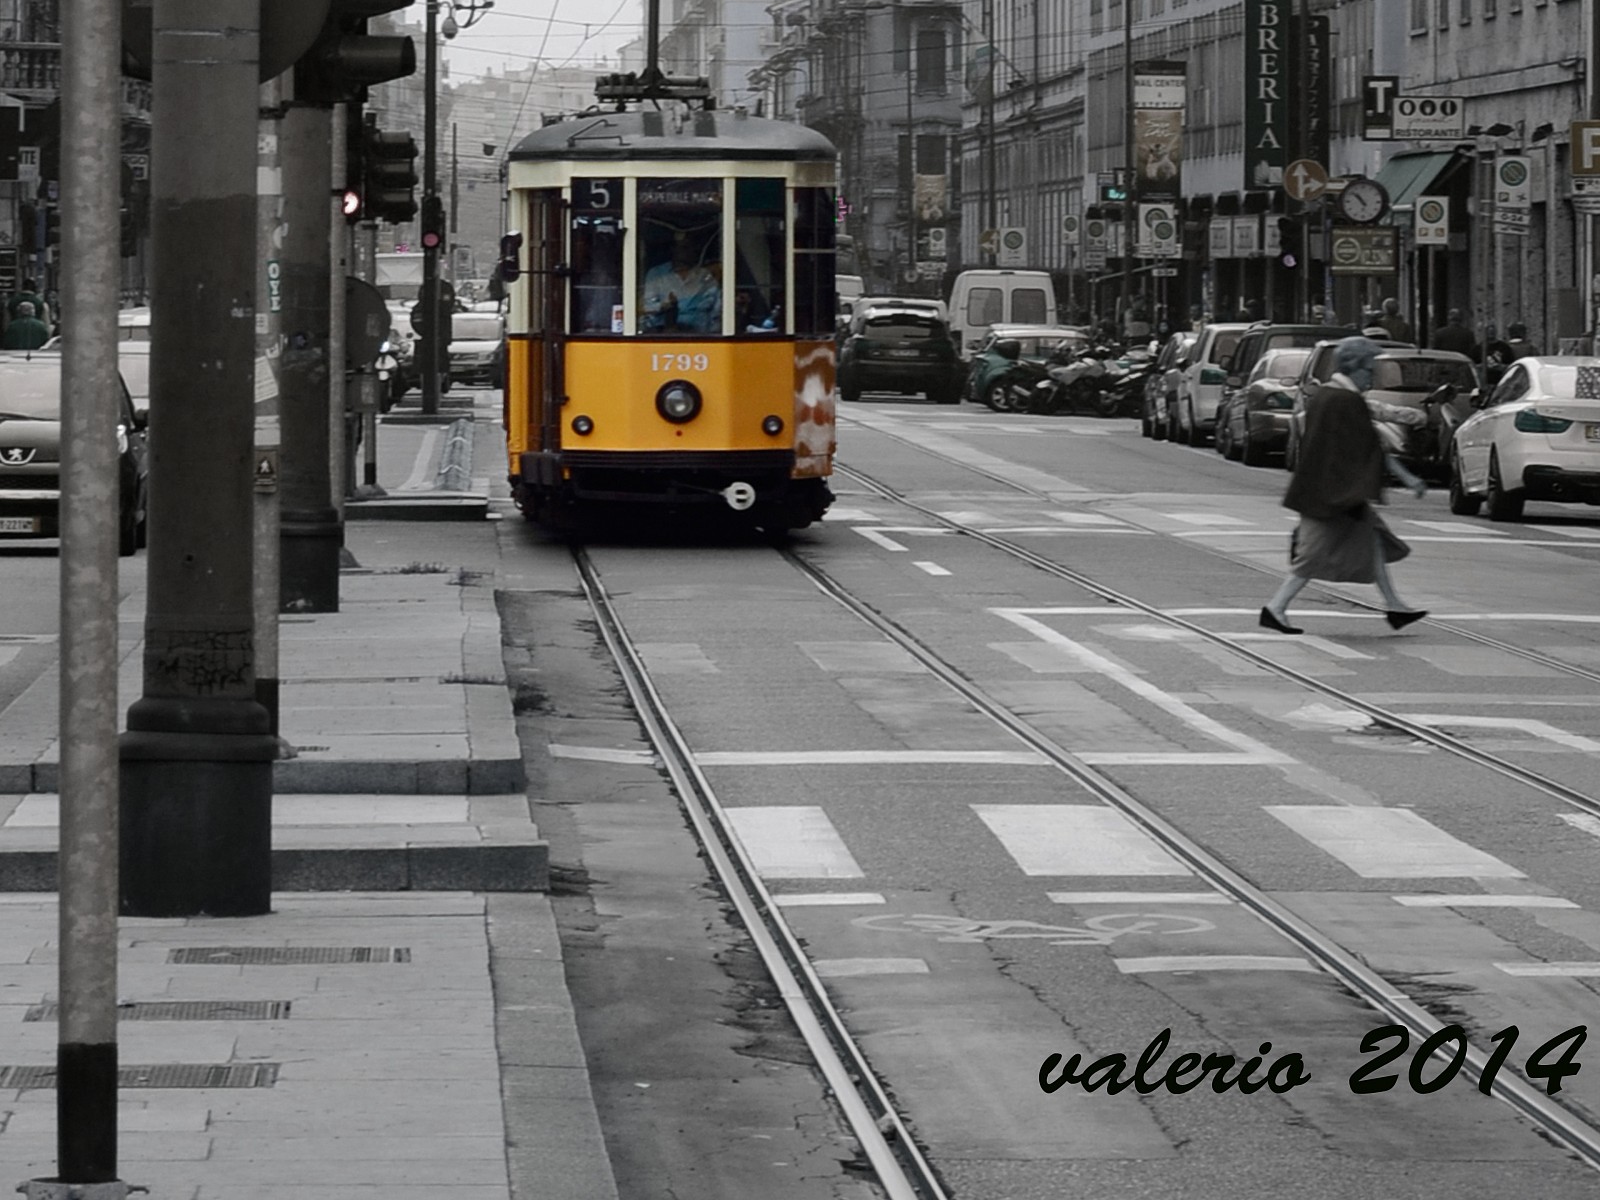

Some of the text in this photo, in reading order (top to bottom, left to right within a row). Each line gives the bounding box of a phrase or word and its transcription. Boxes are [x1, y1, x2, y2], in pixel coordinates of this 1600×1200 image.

[1395, 128, 1461, 138] RISTORANTE
[589, 180, 610, 208] 5
[650, 354, 710, 372] 1799
